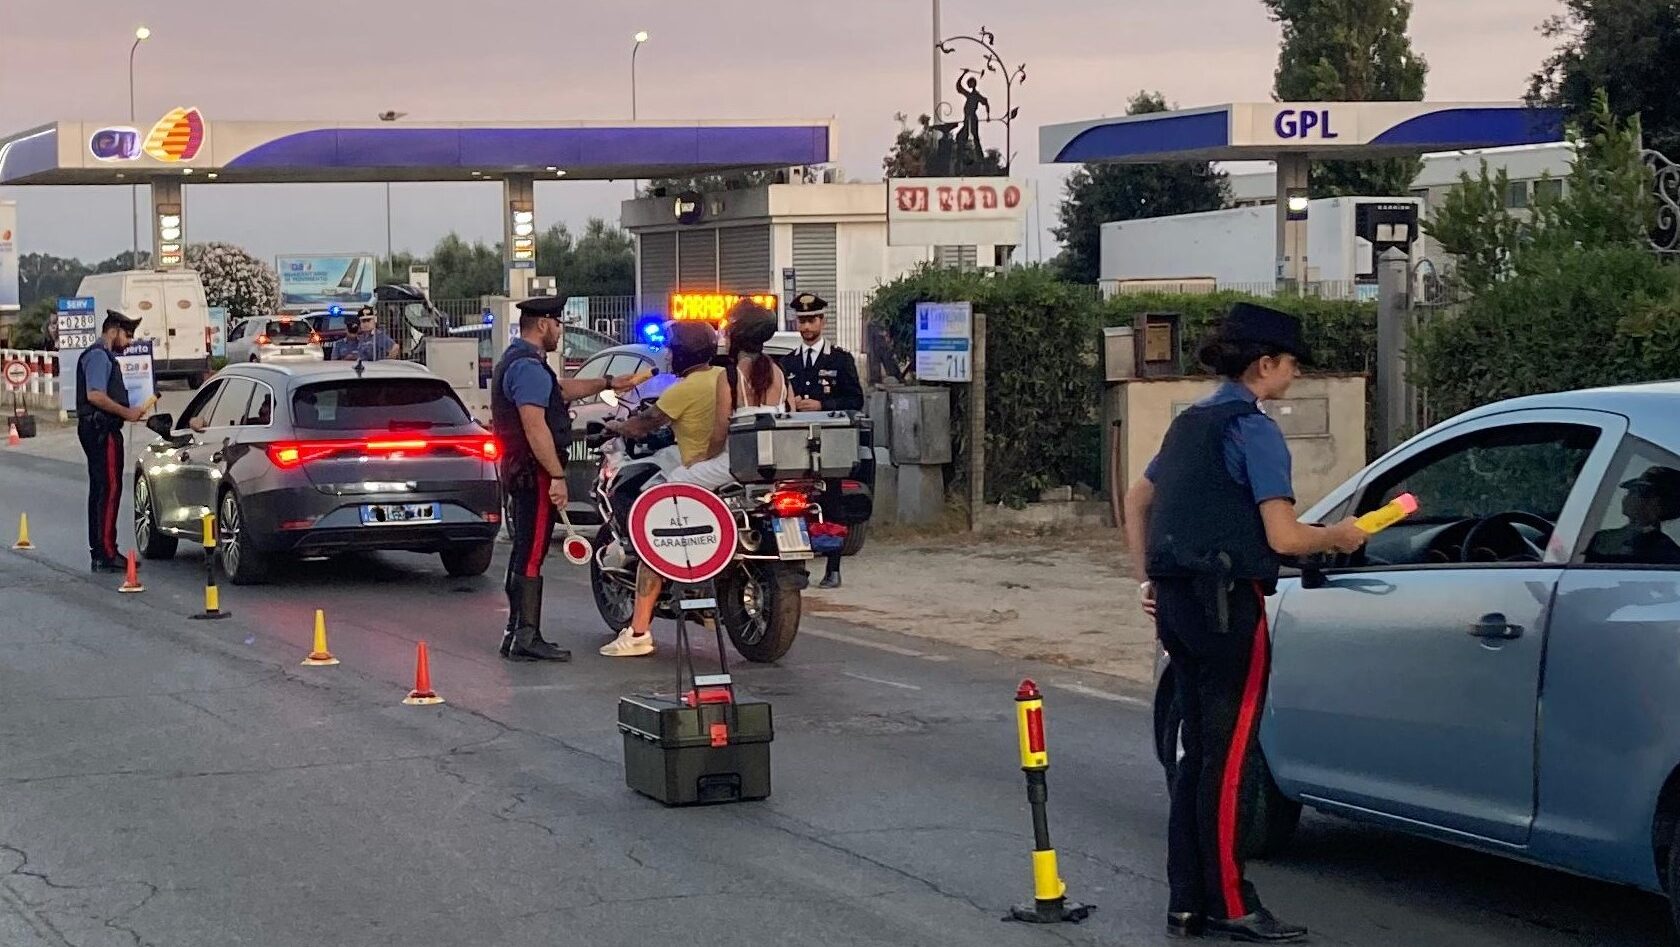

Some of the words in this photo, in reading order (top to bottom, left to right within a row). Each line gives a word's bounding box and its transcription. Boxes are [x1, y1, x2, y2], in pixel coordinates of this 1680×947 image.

[1275, 110, 1338, 138] GPL
[123, 345, 149, 355] perto
[946, 354, 966, 378] 714
[670, 516, 688, 526] ALT
[653, 535, 717, 547] CARABINIERI
